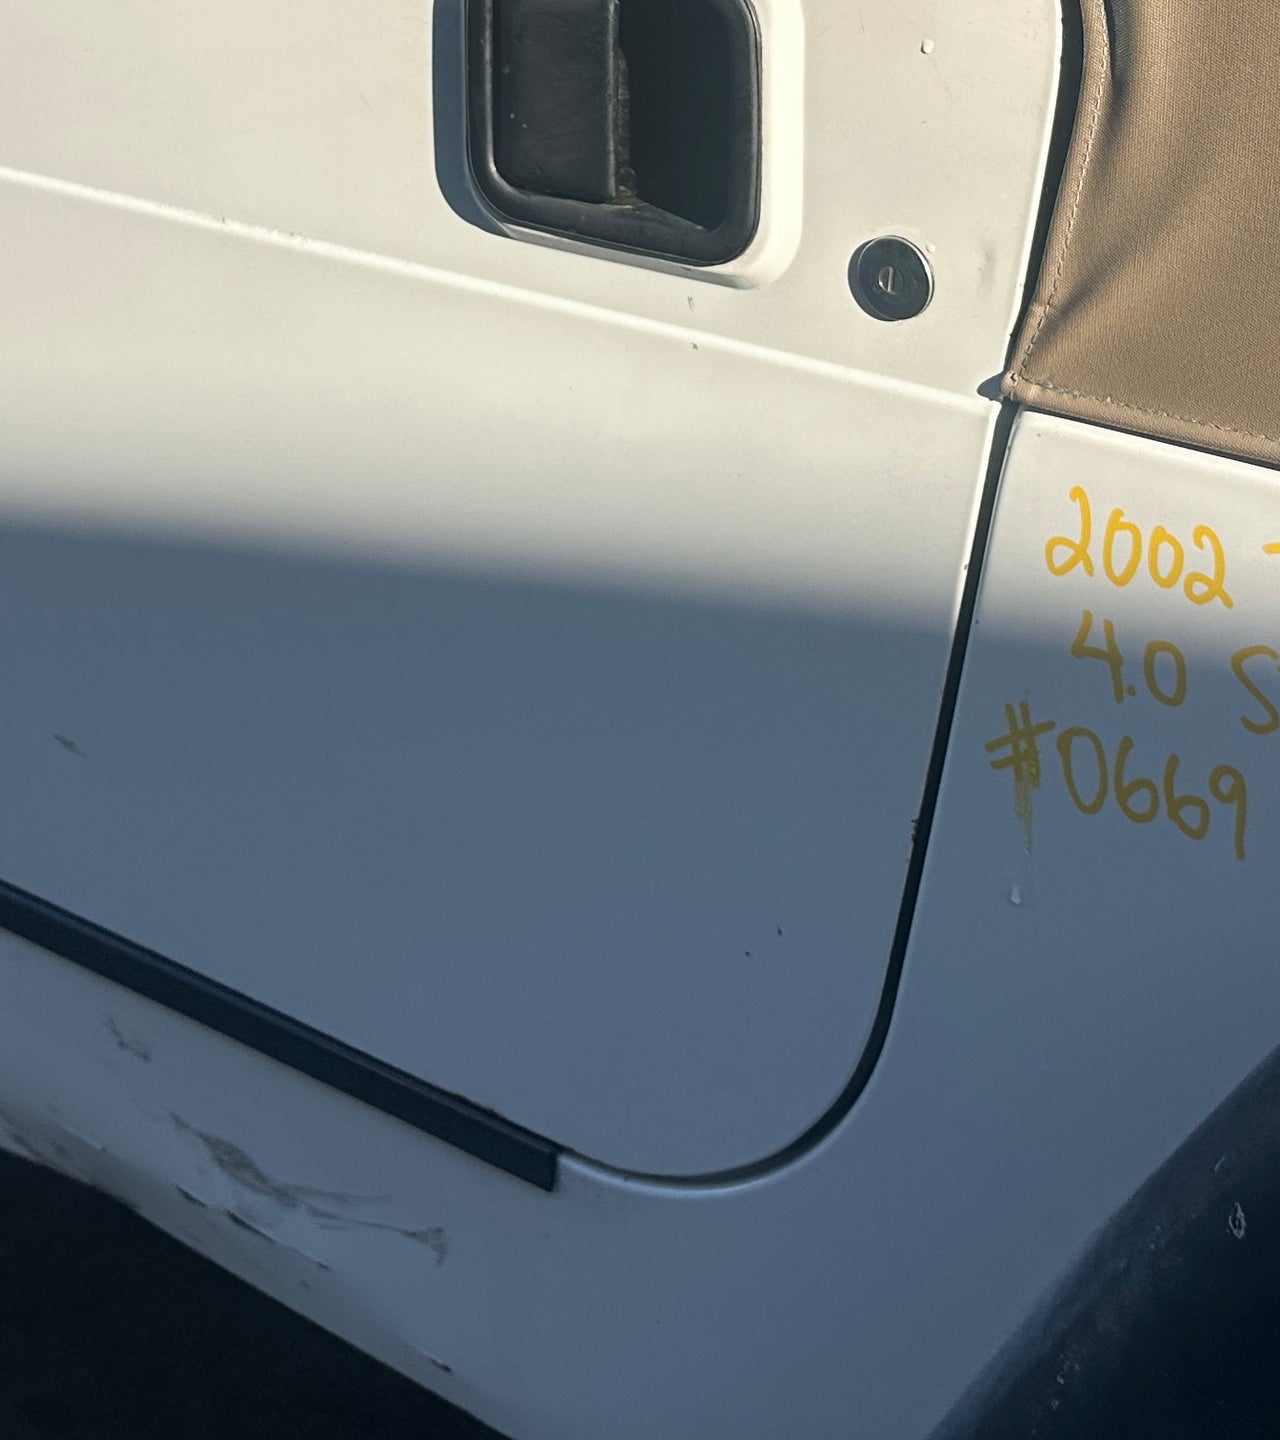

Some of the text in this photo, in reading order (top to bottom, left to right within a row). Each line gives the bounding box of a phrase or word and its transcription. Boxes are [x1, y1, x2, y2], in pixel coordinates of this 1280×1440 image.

[1045, 485, 1234, 610] 2002
[1070, 609, 1187, 707] 4.0
[985, 699, 1248, 860] #0669
